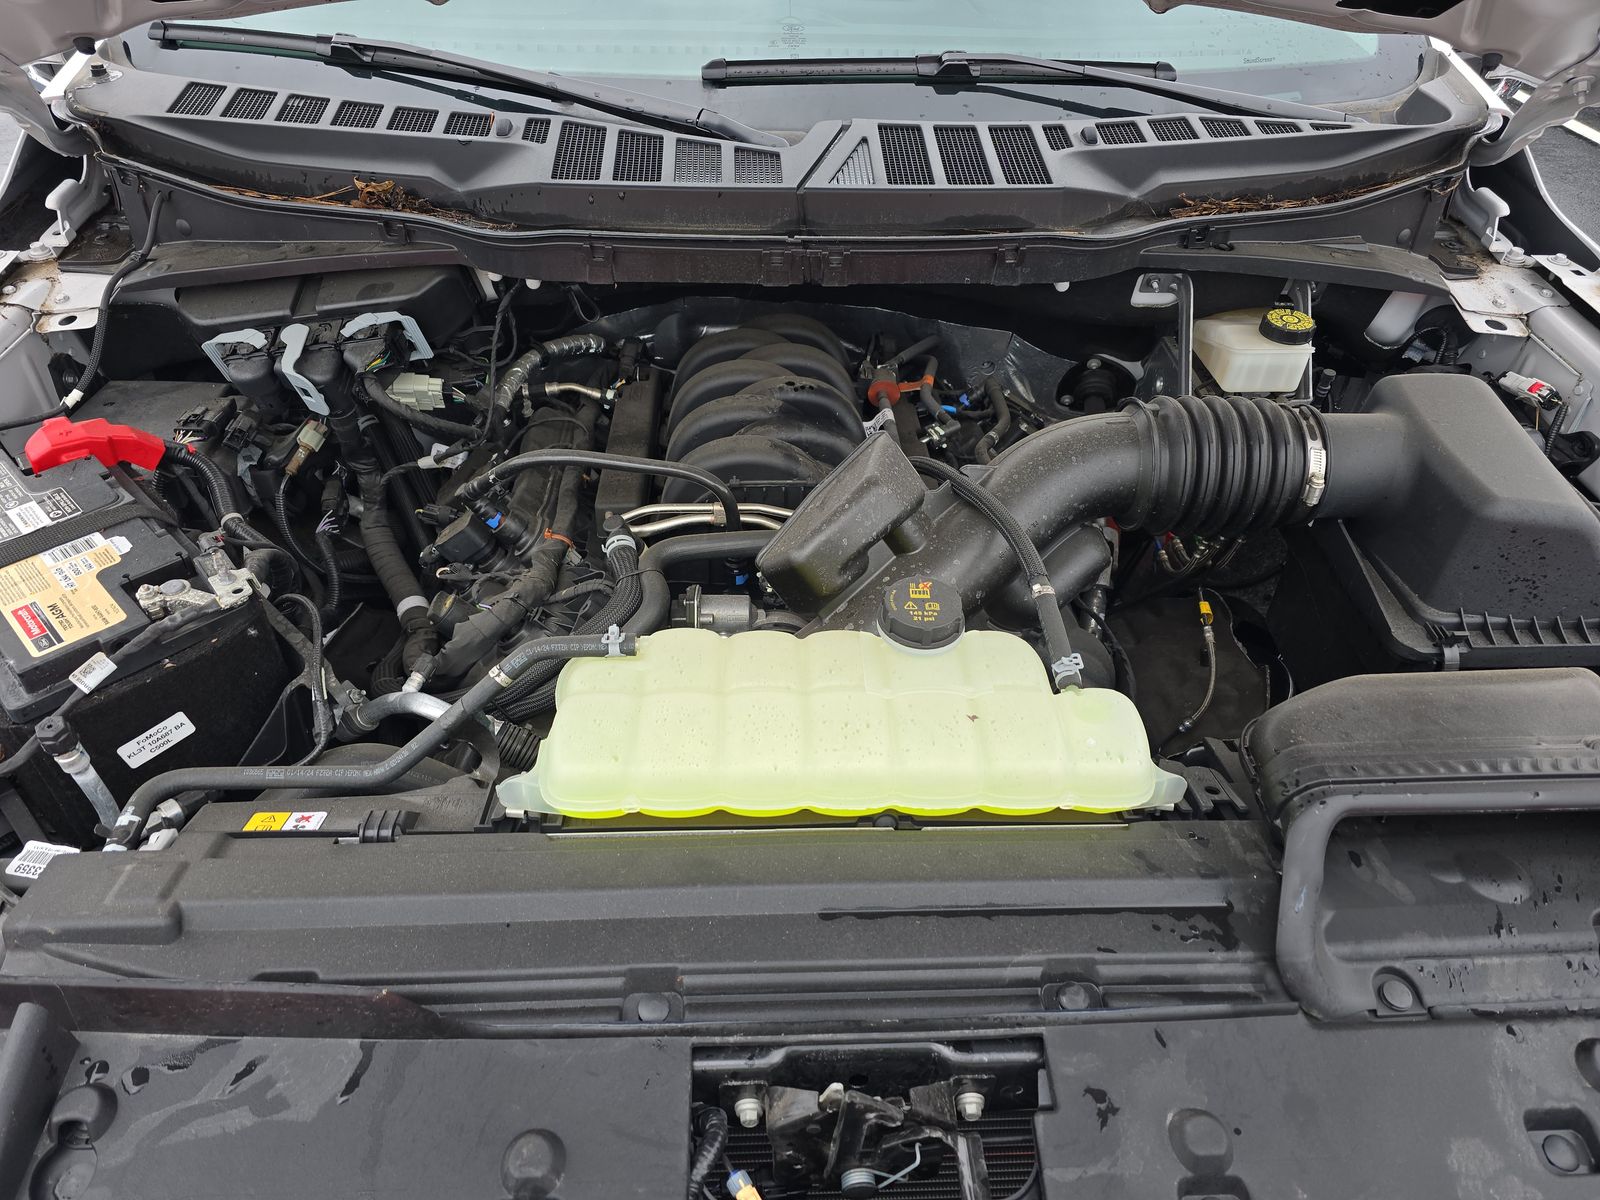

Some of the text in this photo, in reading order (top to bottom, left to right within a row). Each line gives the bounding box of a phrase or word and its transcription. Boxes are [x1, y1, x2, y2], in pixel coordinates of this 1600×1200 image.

[48, 603, 66, 620] AGM
[18, 608, 41, 635] Motorcraft
[127, 722, 186, 760] KL3T 10A687 BA
[136, 725, 168, 746] FoMoCo
[149, 738, 173, 754] C500L
[14, 863, 42, 876] 3359
